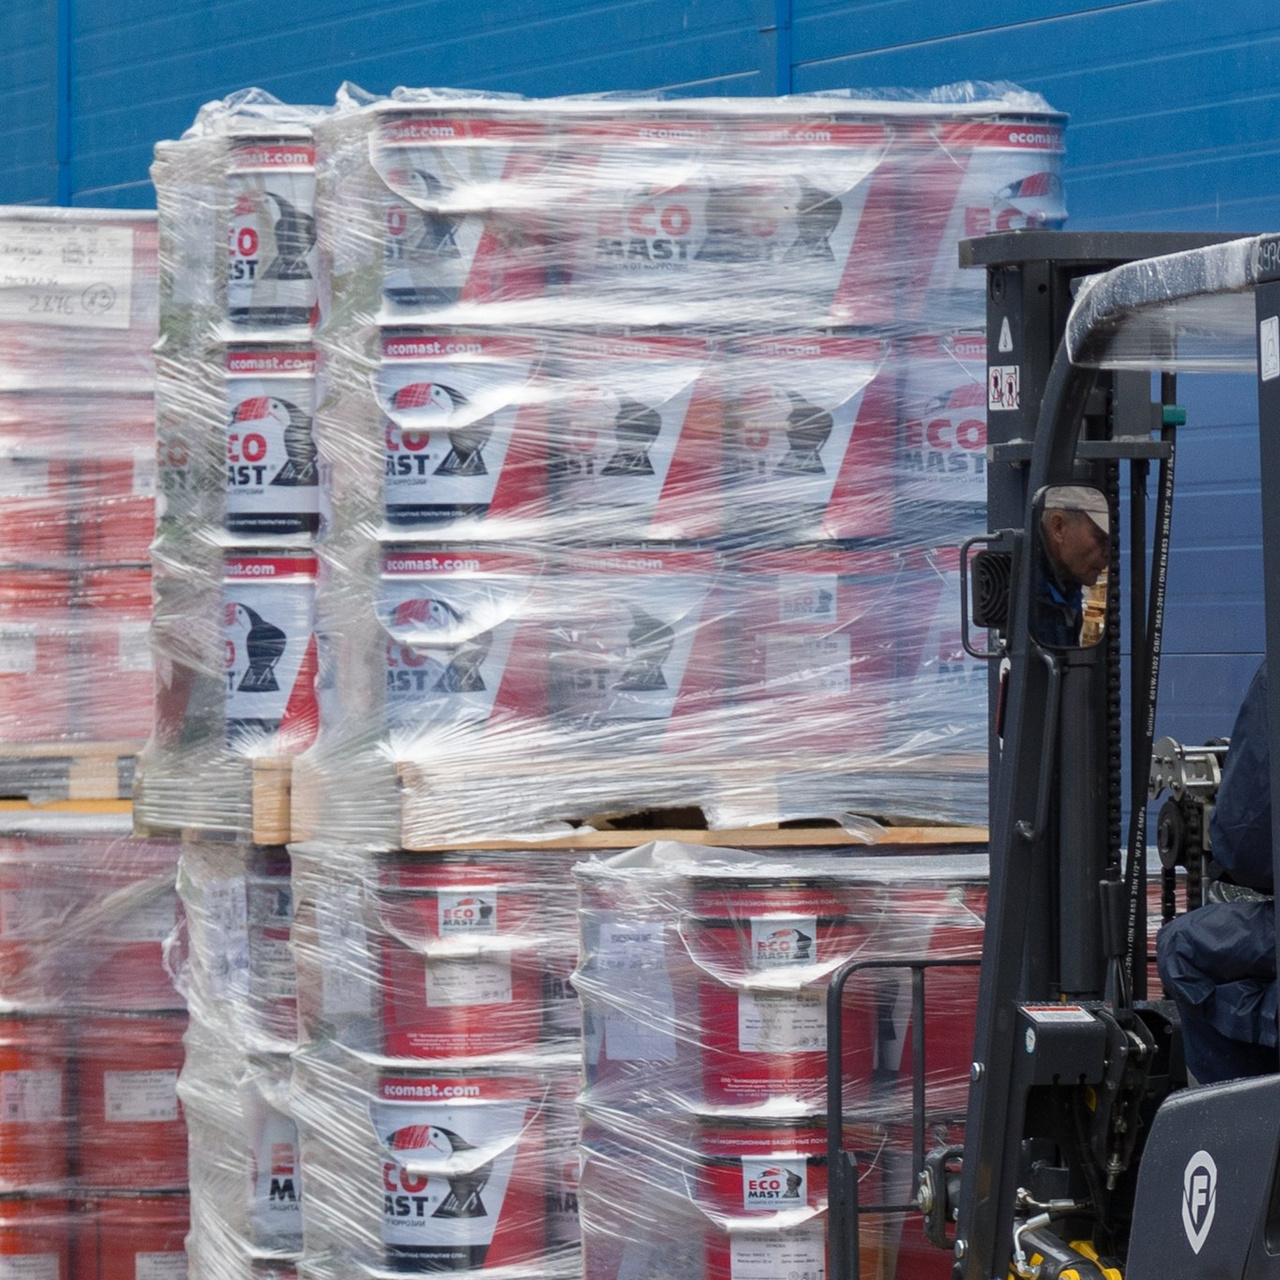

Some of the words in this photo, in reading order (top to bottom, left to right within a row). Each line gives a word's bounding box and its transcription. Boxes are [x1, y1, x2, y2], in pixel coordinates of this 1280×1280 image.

[904, 418, 987, 451] ECO
[385, 454, 431, 476] AST
[1160, 554, 1168, 567] EN
[1158, 567, 1166, 583] DIN
[748, 1179, 781, 1191] ECO
[748, 1190, 781, 1199] MAST
[383, 1196, 429, 1218] AST
